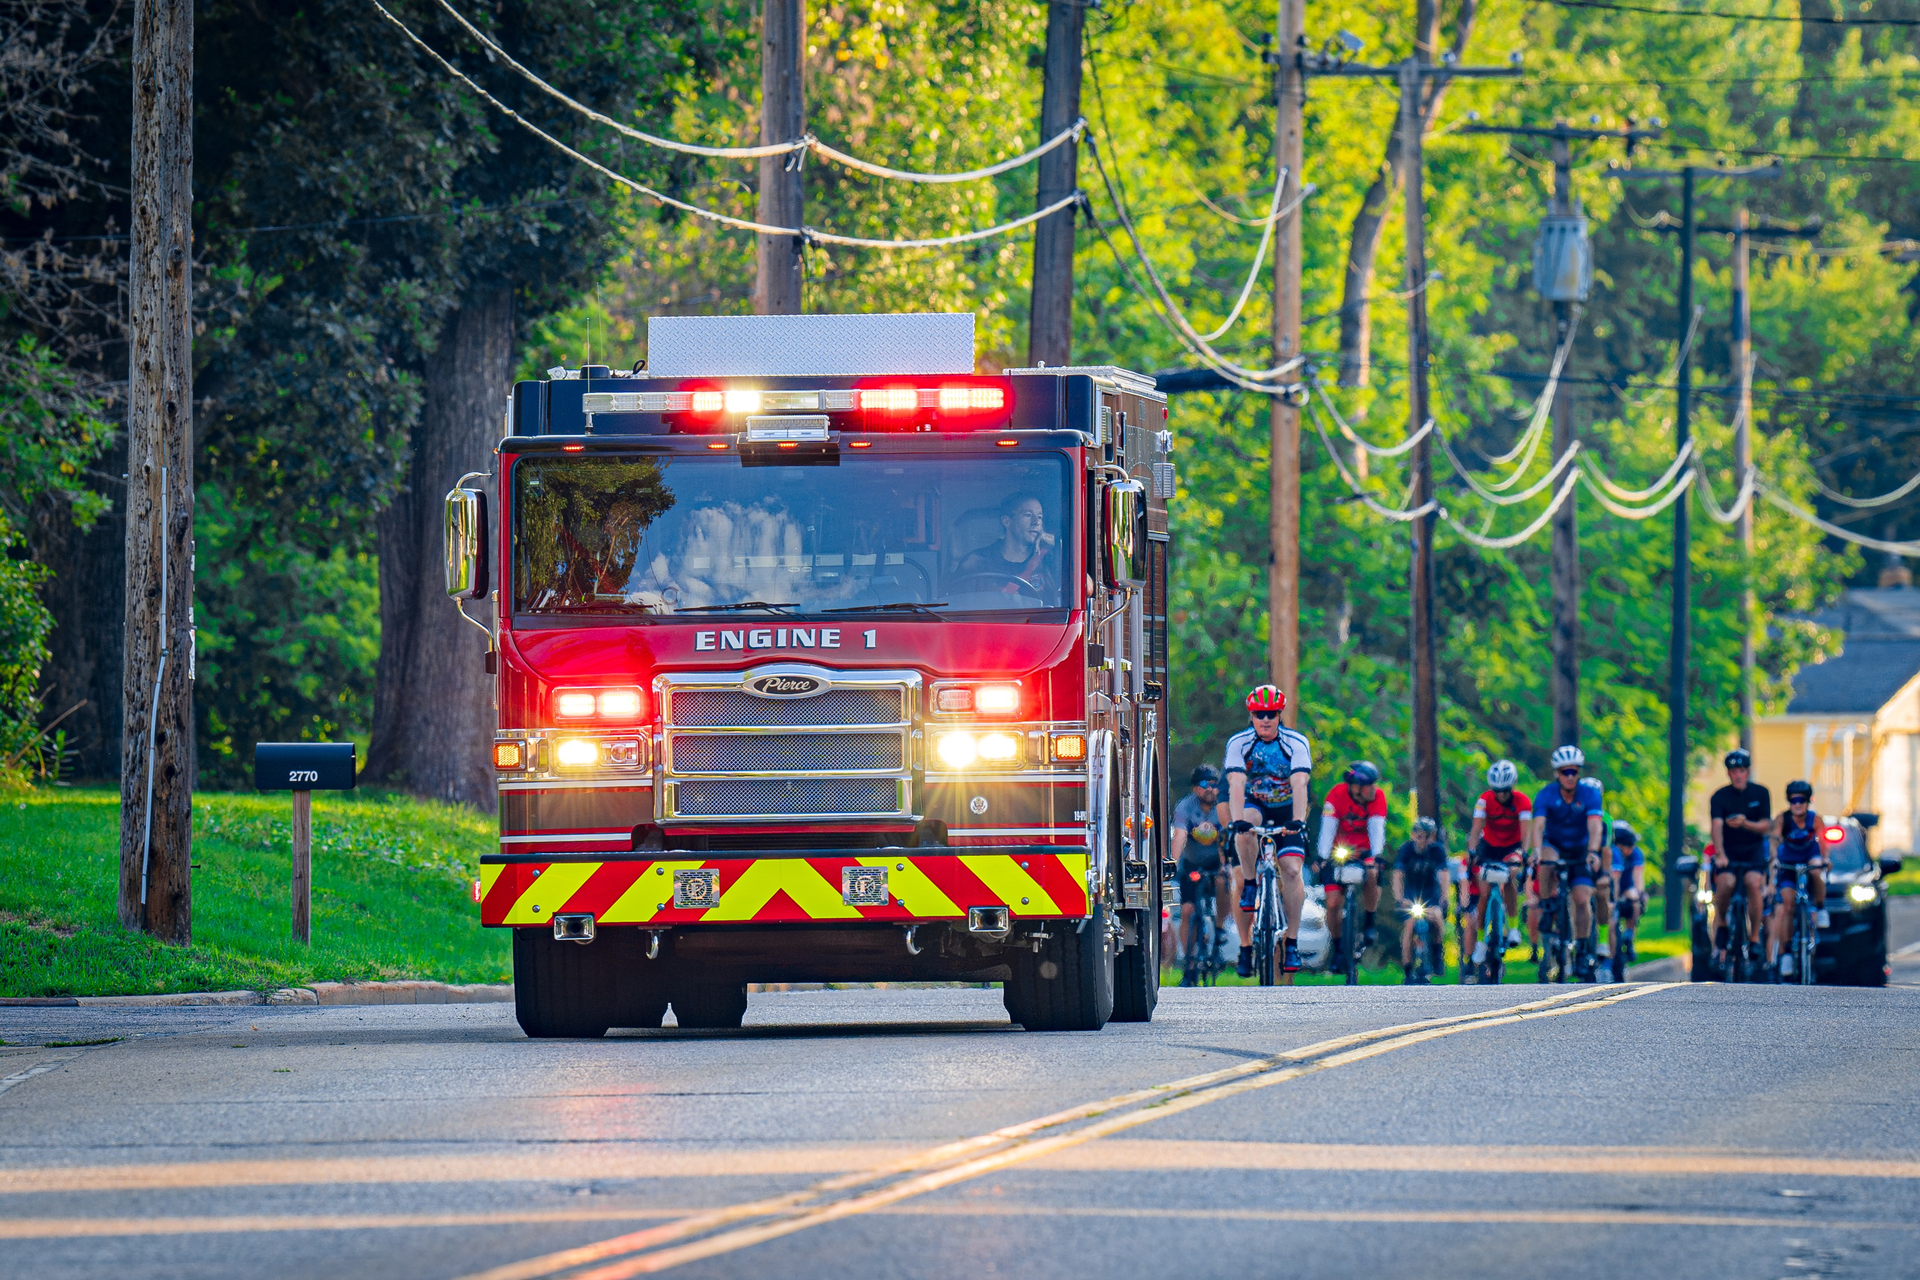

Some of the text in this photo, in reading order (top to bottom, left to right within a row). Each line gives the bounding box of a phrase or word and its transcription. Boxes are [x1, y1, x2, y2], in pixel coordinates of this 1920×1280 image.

[694, 628, 877, 652] ENGINE 1
[761, 677, 811, 693] Pierce
[289, 770, 318, 782] 2770
